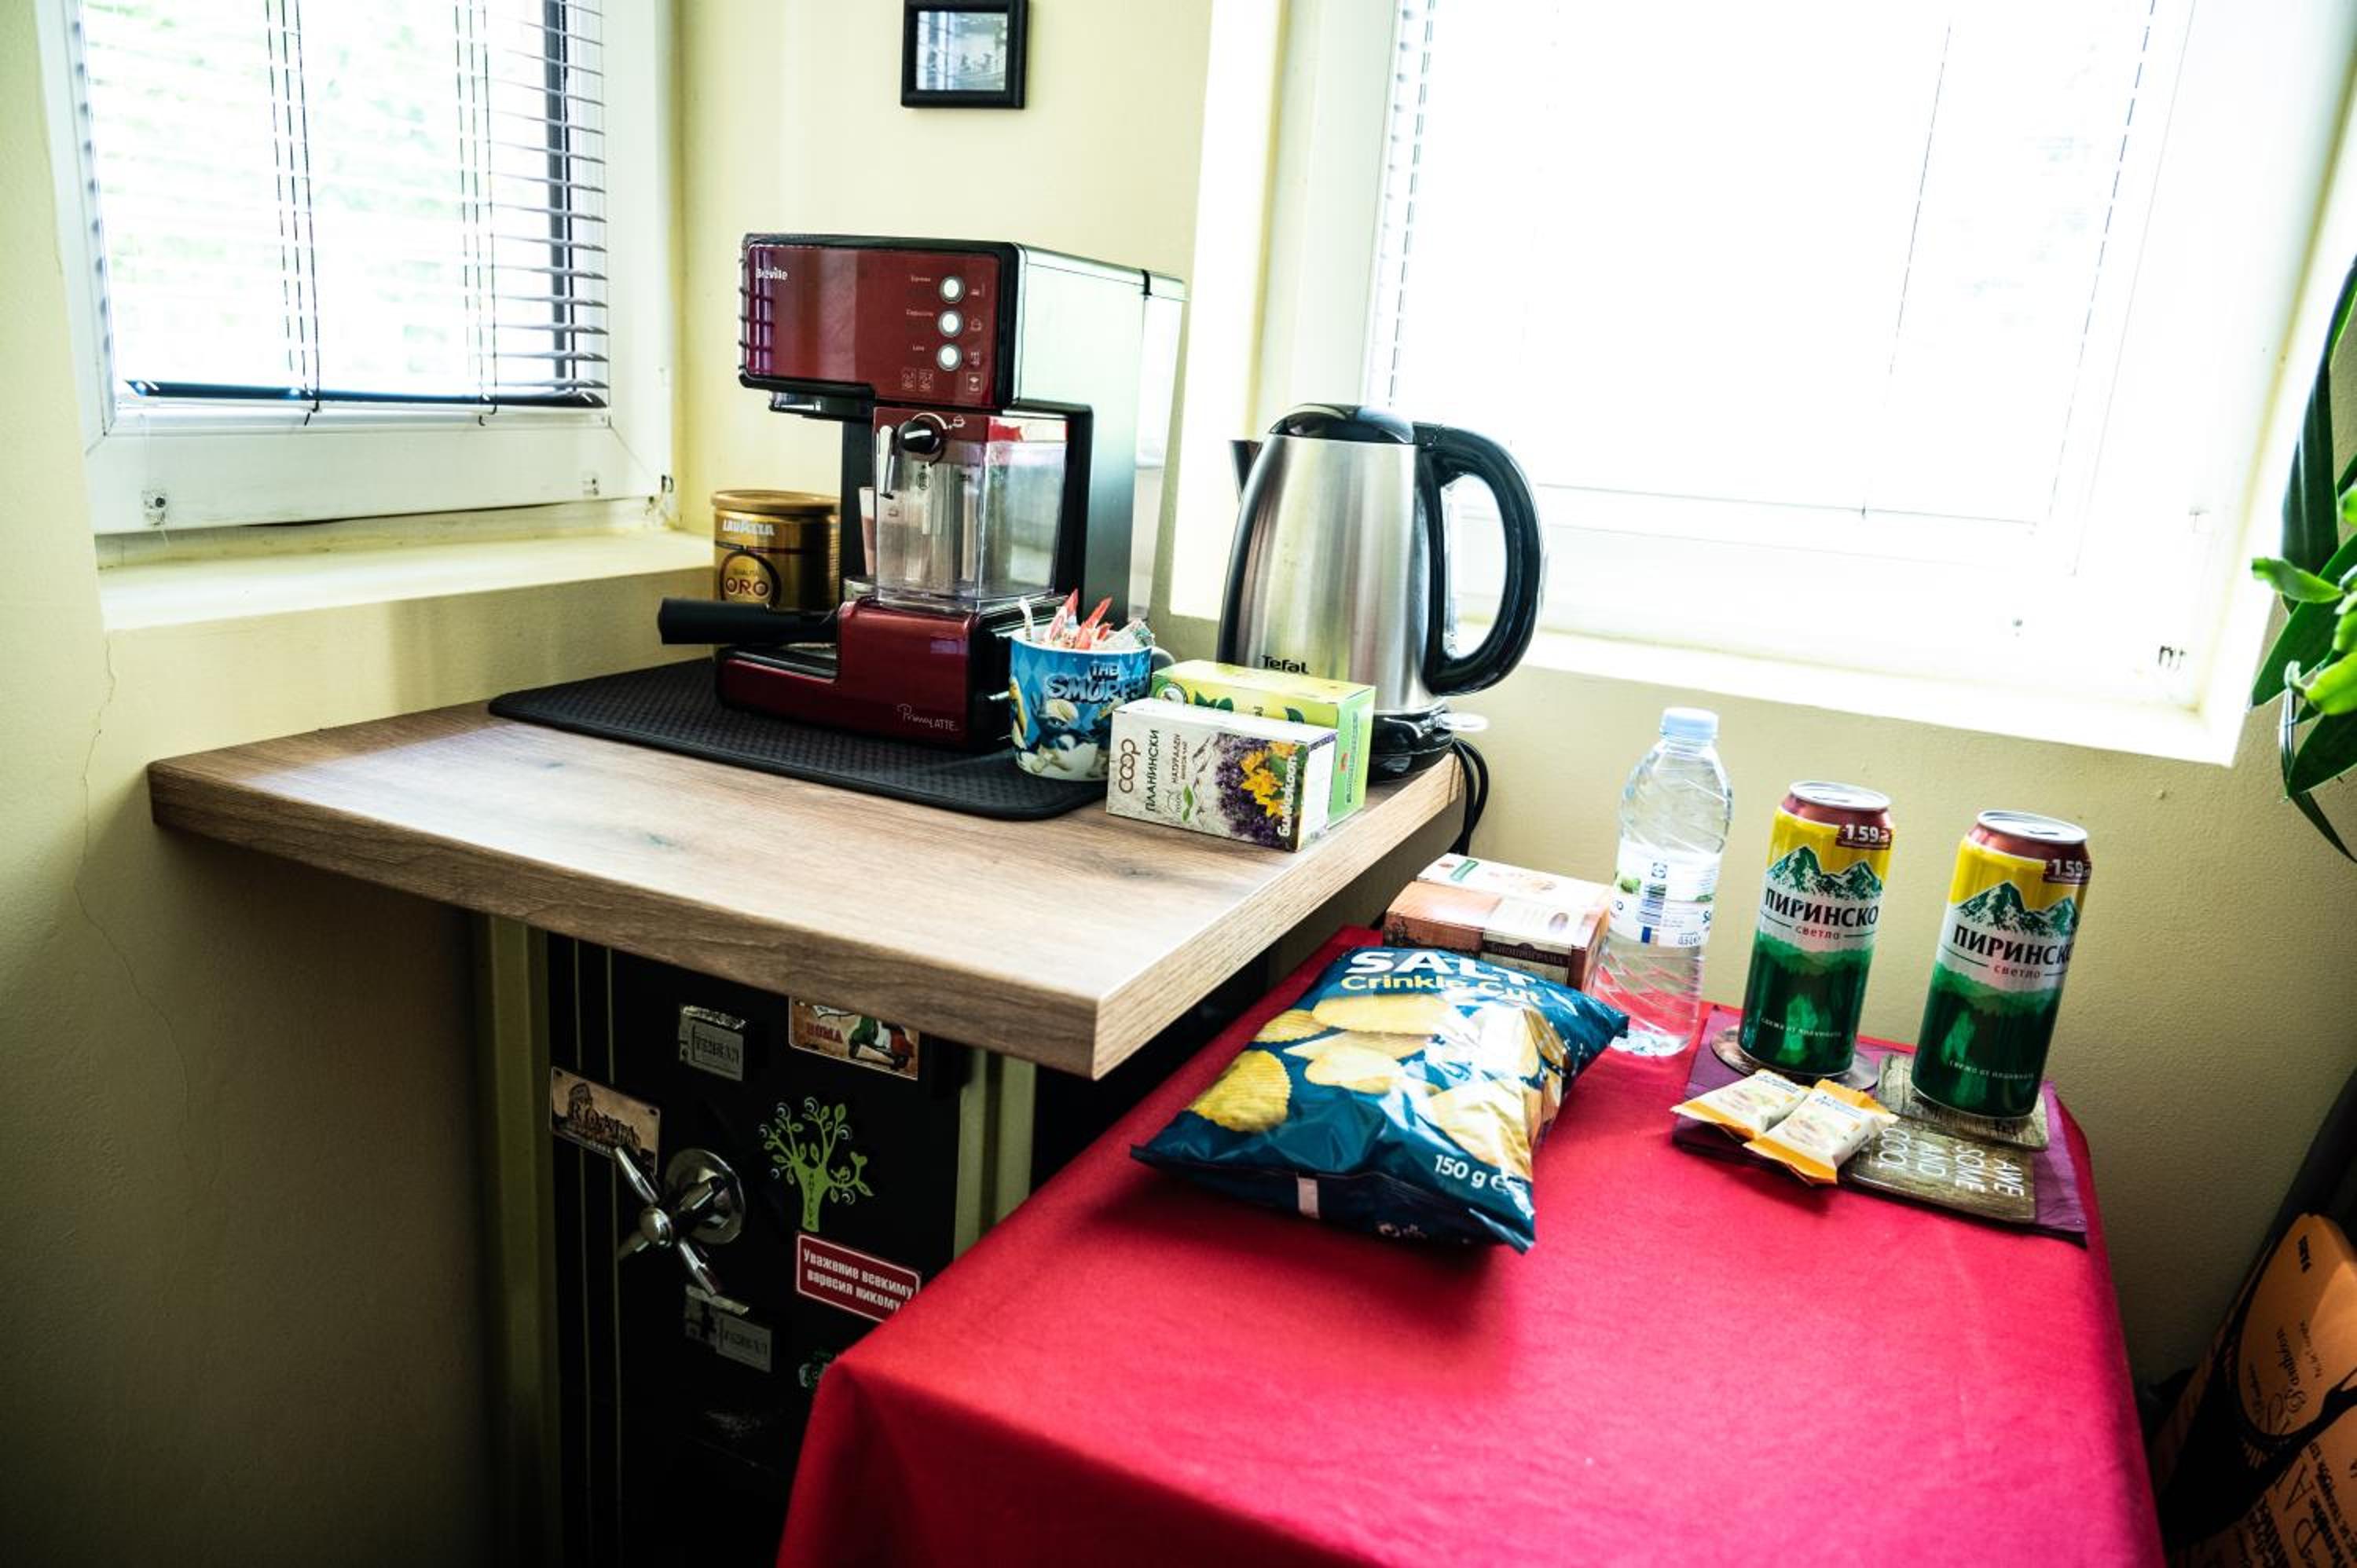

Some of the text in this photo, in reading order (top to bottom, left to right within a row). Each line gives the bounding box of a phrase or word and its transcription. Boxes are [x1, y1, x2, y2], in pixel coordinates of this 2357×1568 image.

[725, 577, 769, 597] ORO
[1089, 661, 1120, 678] THE
[1262, 654, 1309, 674] Tefal
[1144, 729, 1160, 813] ПЛАНИНСКИ
[1765, 888, 1879, 928] ПИРИНСКО
[1795, 926, 1840, 940] светло
[1340, 974, 1468, 991] Crinkle
[1345, 951, 1537, 986] SALT
[1993, 965, 2041, 979] светло
[1877, 1127, 1910, 1171] COOL
[1915, 1140, 1946, 1177] AND
[1435, 1153, 1469, 1180] 150
[1470, 1170, 1487, 1189] g
[1955, 1145, 1986, 1194] SOME
[1993, 1157, 2025, 1197] AWE
[803, 1247, 859, 1280] Уважение
